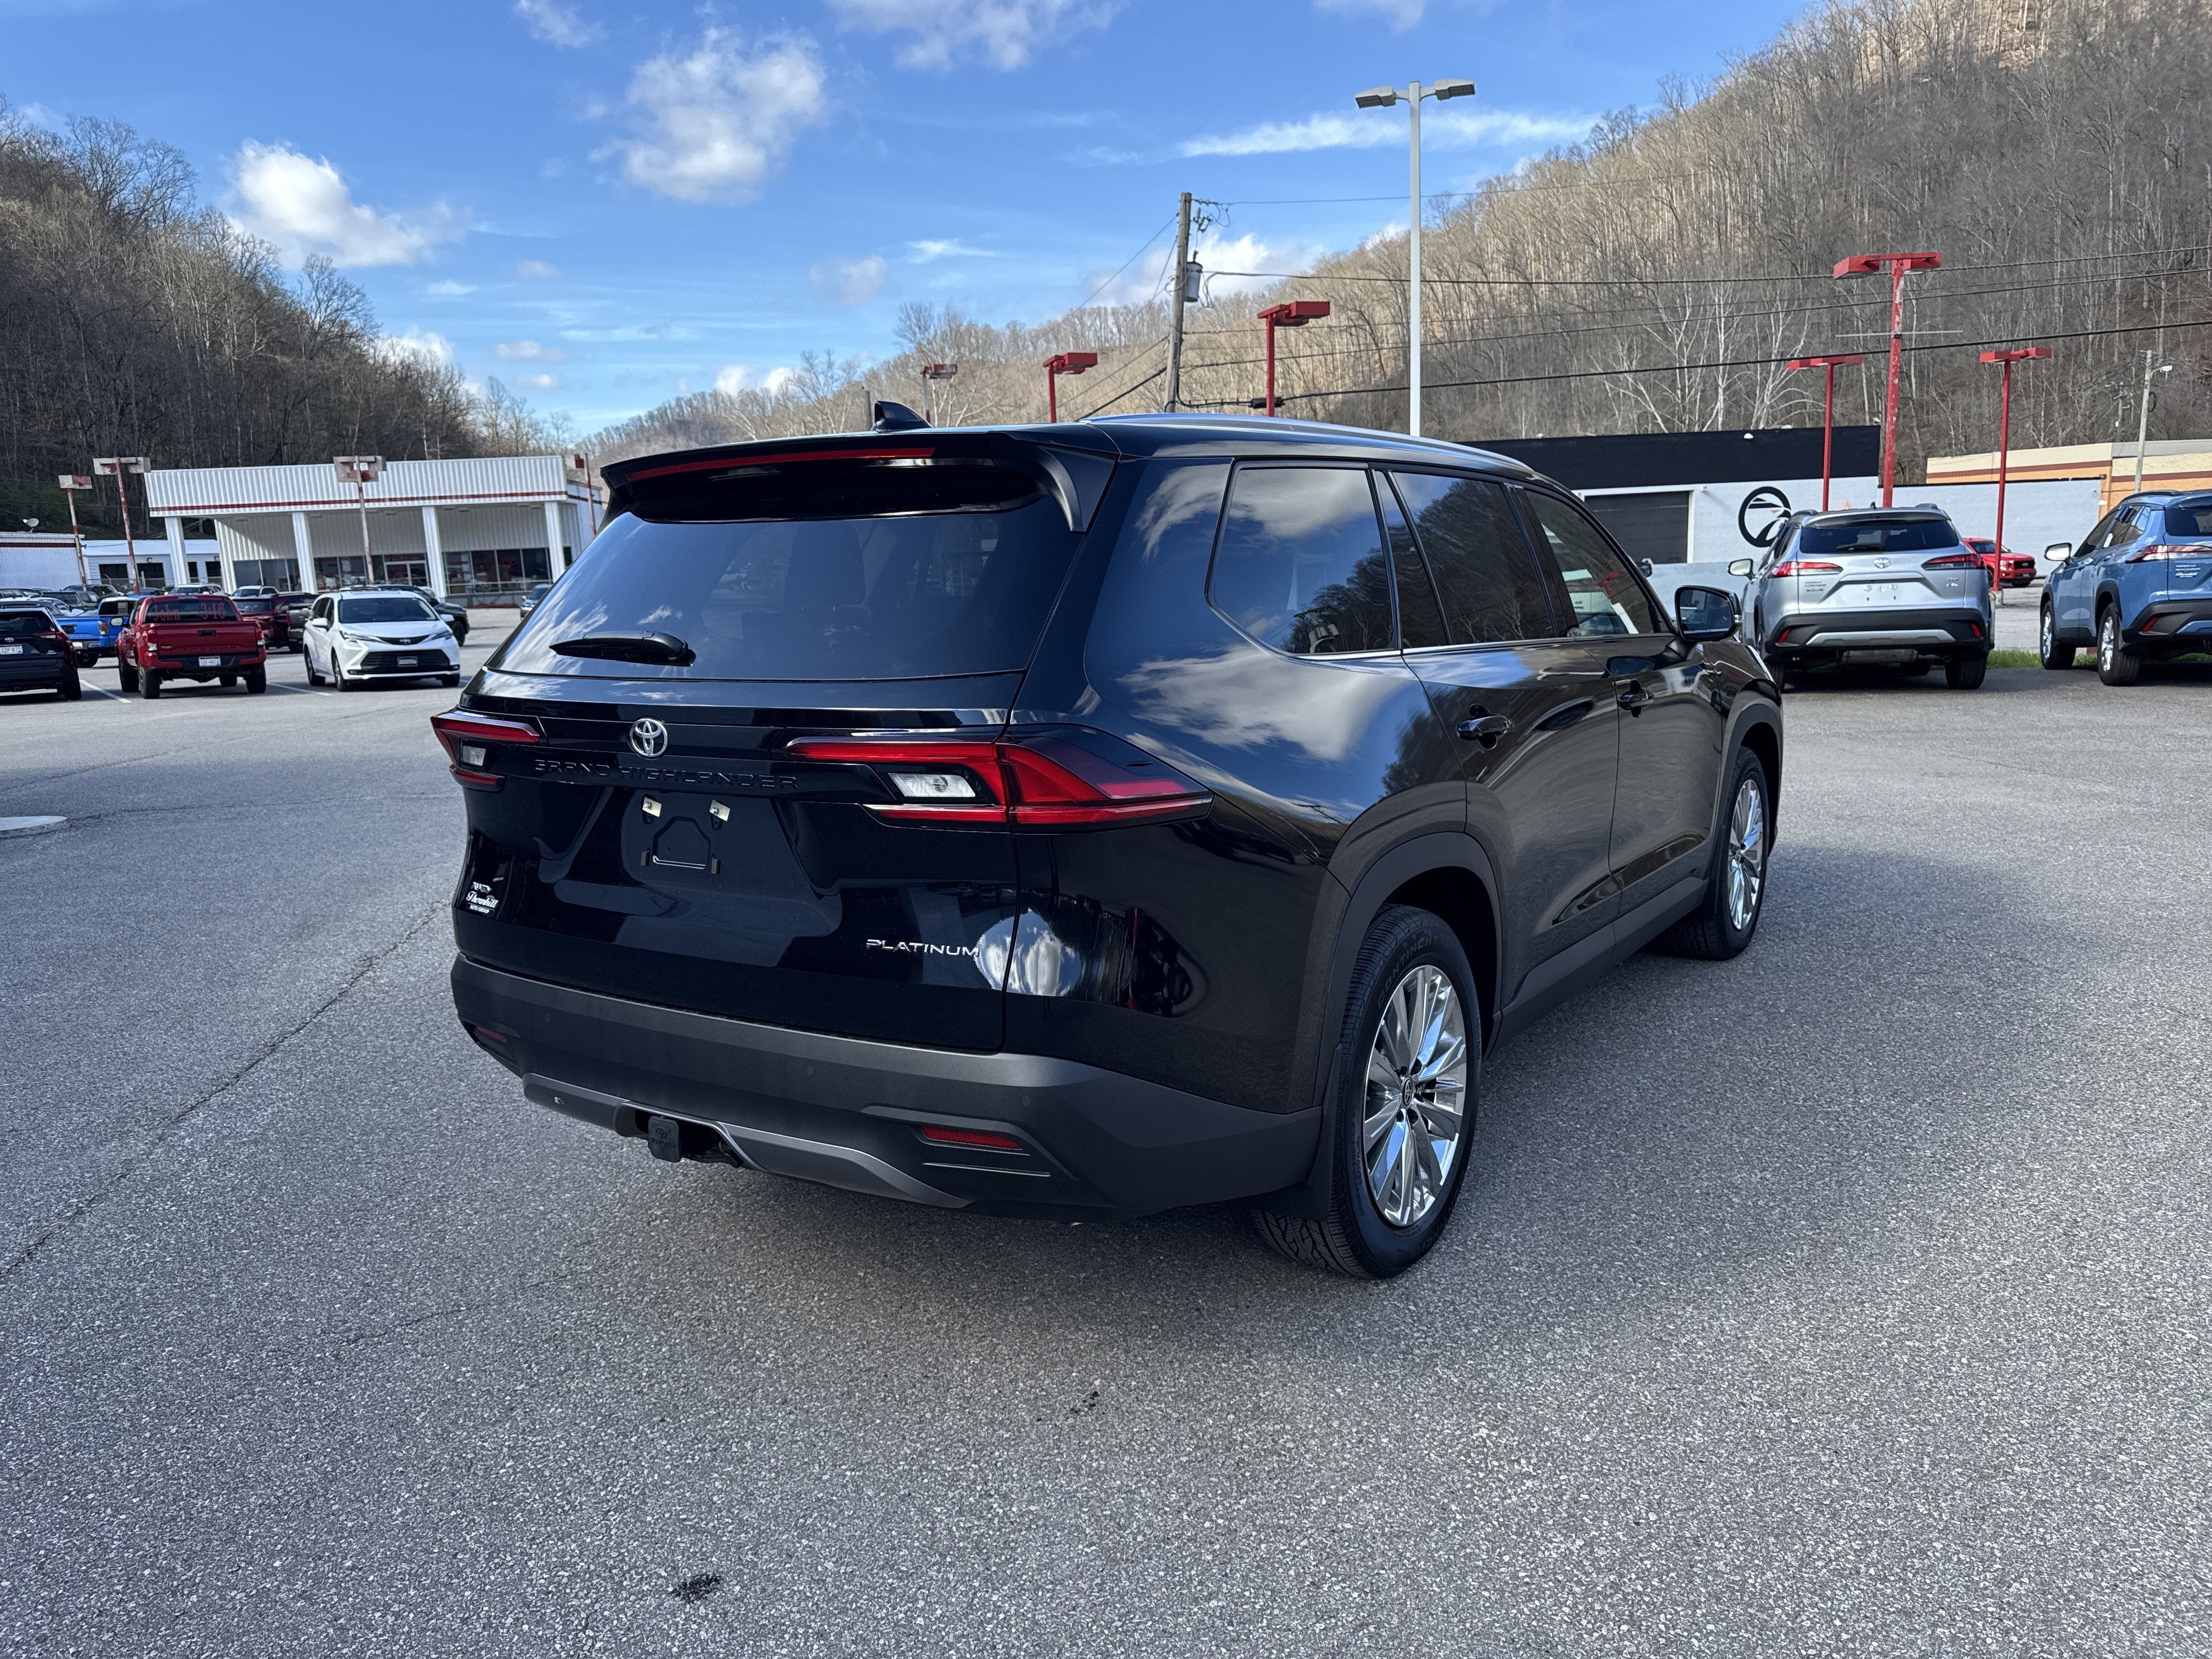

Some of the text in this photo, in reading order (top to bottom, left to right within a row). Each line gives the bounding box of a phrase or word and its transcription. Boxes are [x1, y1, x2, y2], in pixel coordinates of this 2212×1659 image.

[153, 602, 226, 621] John 3:16
[534, 759, 798, 789] GRAND HIGHLANDER
[466, 891, 499, 909] Thornhill
[866, 939, 981, 957] PLATINUM
